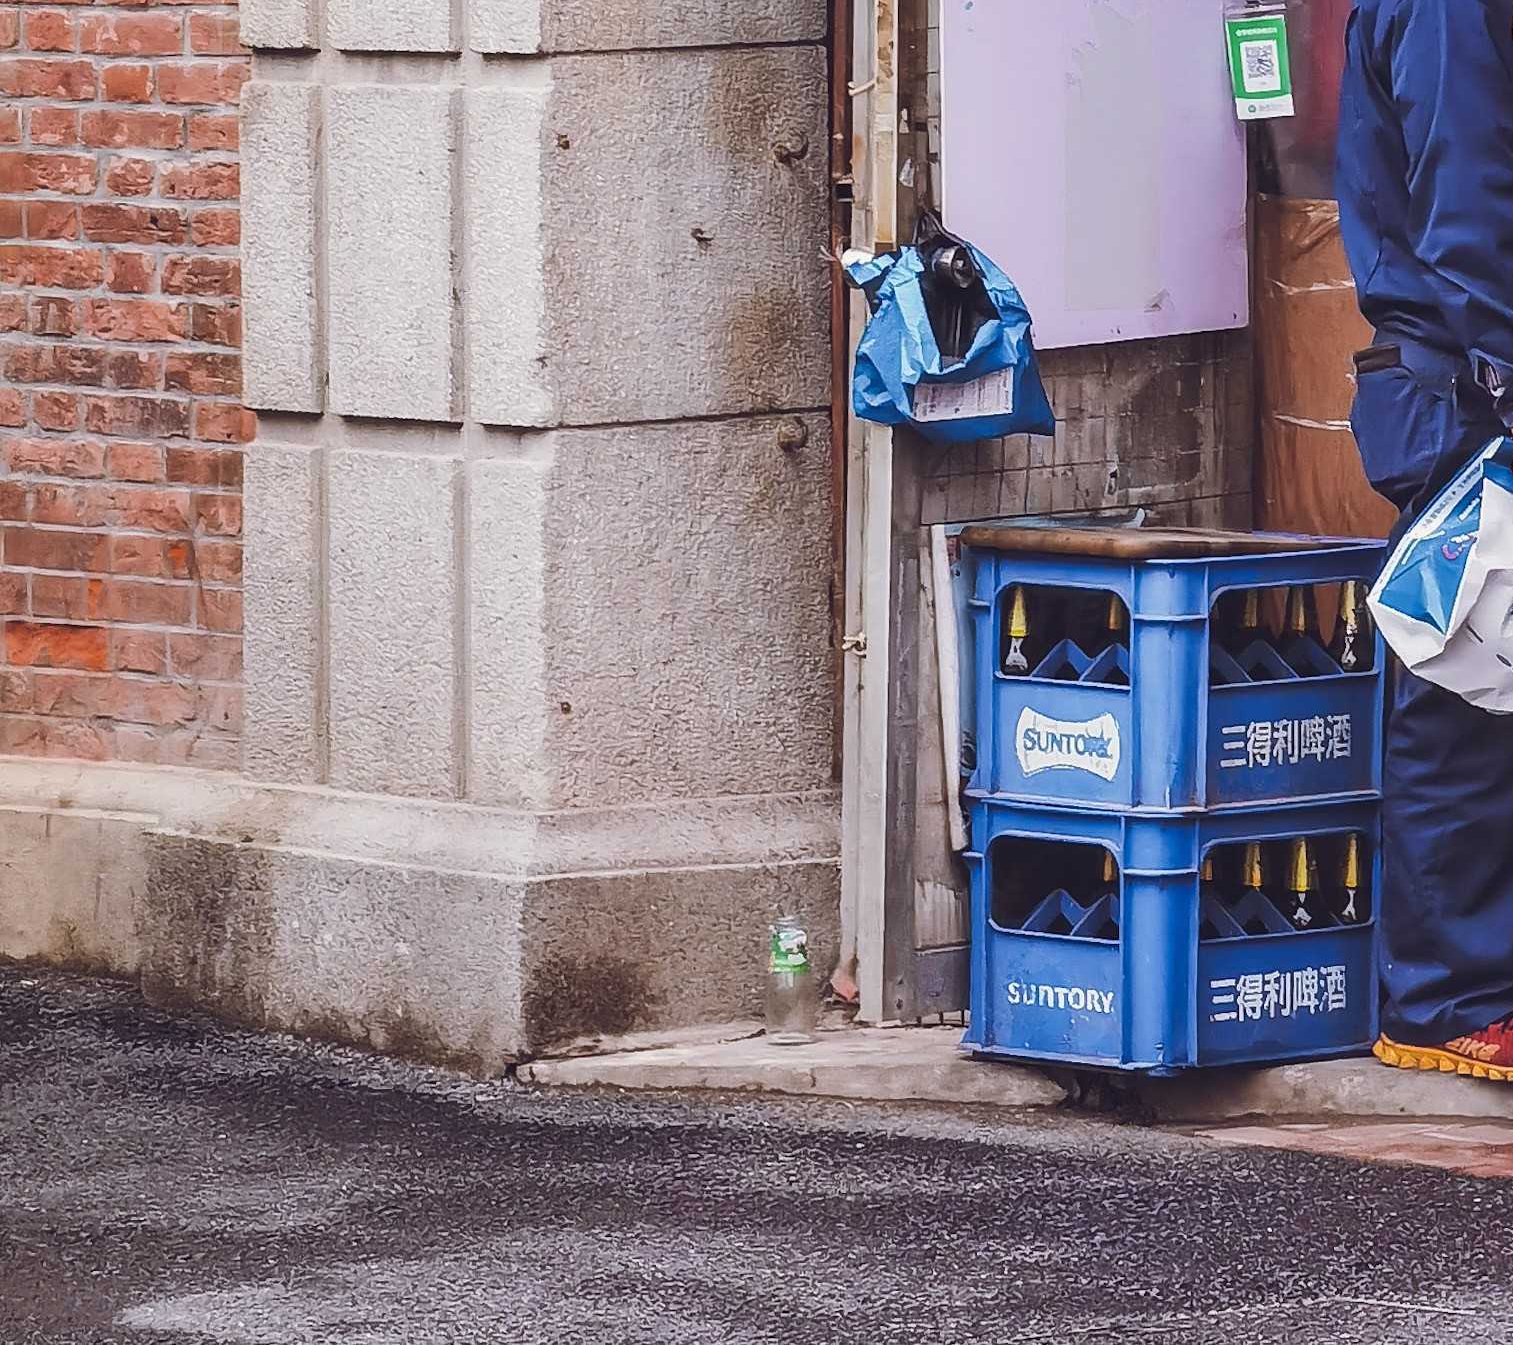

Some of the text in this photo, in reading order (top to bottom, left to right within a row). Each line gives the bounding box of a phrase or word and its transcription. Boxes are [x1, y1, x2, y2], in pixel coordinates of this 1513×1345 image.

[1220, 714, 1351, 769] 三得利啤酒
[1007, 982, 1114, 1014] SUNTORY
[1210, 965, 1346, 1022] 三得利啤酒
